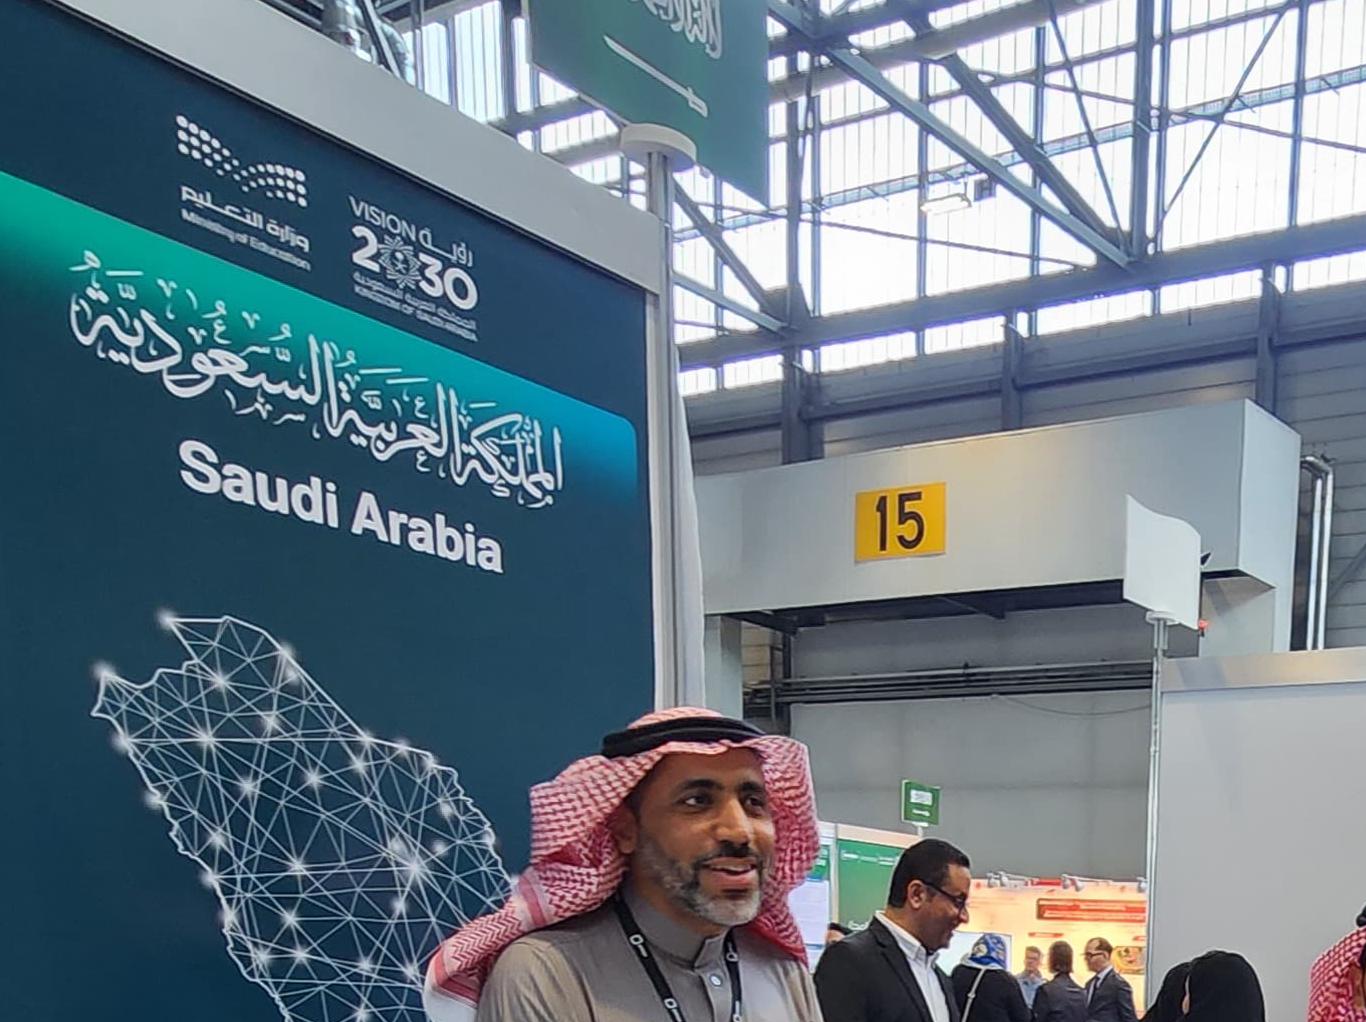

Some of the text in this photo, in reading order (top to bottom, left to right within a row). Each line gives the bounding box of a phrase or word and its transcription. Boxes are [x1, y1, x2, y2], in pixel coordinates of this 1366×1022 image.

[265, 219, 310, 253] وزارة
[349, 195, 418, 243] VISION
[248, 236, 312, 272] Education
[418, 227, 474, 267] رؤية
[178, 440, 505, 575] Saudi Arabia
[876, 491, 925, 552] 15
